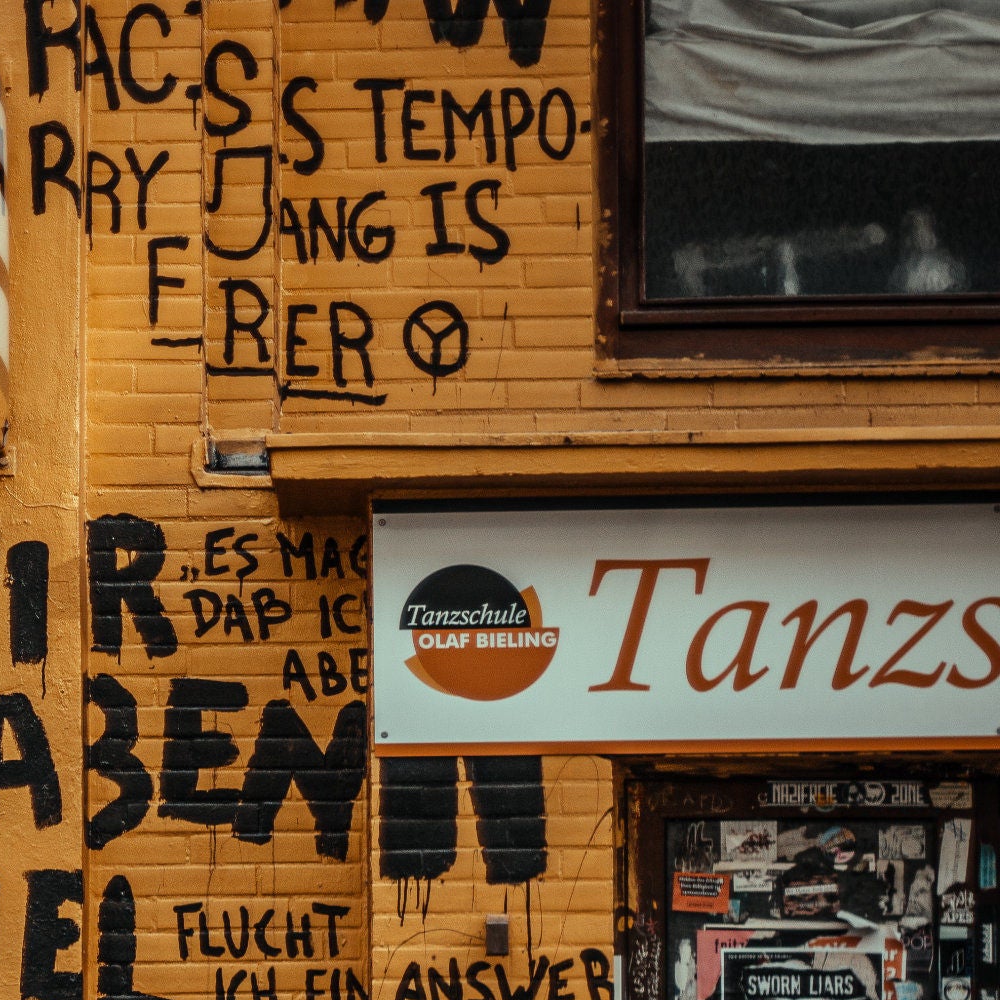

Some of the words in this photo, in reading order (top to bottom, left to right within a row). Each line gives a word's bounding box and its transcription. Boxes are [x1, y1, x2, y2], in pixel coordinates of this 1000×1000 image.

[421, 180, 510, 268] IS
[407, 603, 528, 627] Tanzschule
[588, 557, 1000, 692] Tanzs
[418, 632, 470, 650] OLAF
[476, 631, 558, 649] BIELING
[891, 783, 926, 805] ZONE
[173, 903, 350, 960] FLUCHT
[809, 976, 854, 996] LIARS
